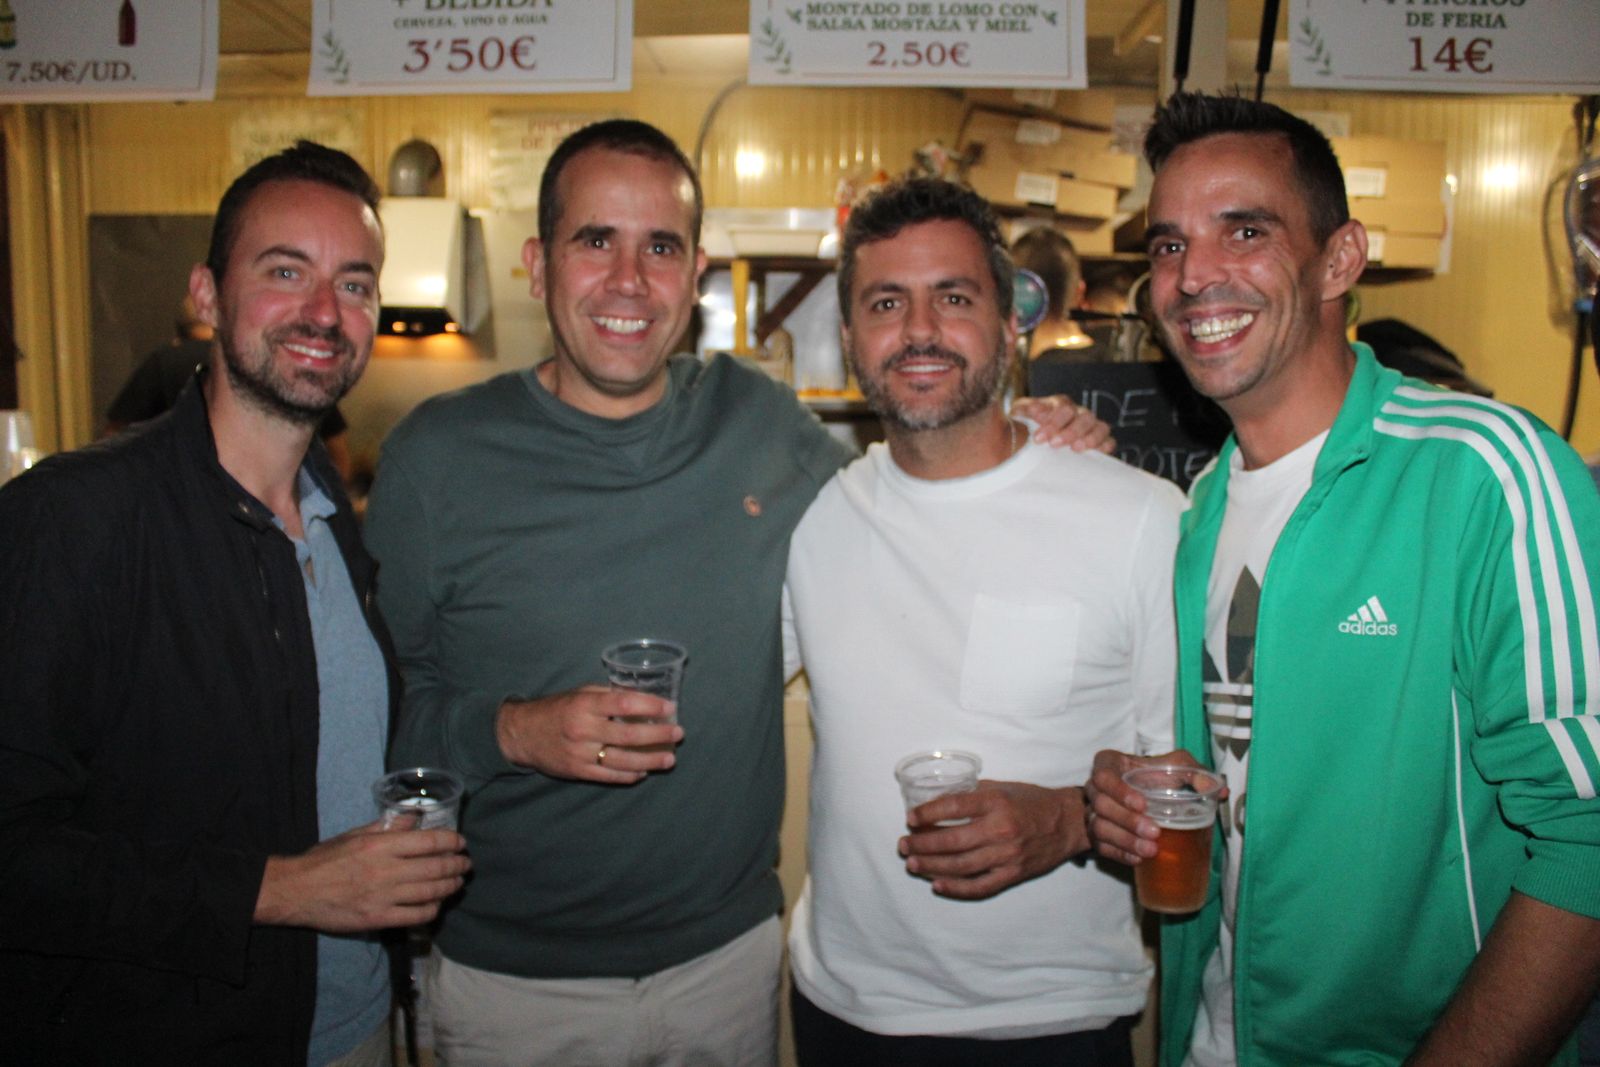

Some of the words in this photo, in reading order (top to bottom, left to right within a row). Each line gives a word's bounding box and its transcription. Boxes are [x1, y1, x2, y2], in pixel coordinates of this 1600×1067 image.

[806, 2, 900, 16] MONTADO
[907, 2, 932, 16] DE
[939, 3, 993, 16] LOMO
[999, 3, 1039, 16] CON
[463, 15, 494, 26] VINO
[497, 14, 508, 26] O
[513, 13, 549, 25] AGUA
[806, 17, 866, 31] SALSA
[871, 18, 961, 31] MOSTAZA
[966, 18, 979, 31] Y
[985, 18, 1032, 32] MIEL
[1406, 12, 1434, 27] DE
[1442, 12, 1507, 28] FERIA
[866, 41, 971, 67] 2,50€
[1408, 36, 1494, 73] 14€
[1338, 621, 1397, 636] adidas
